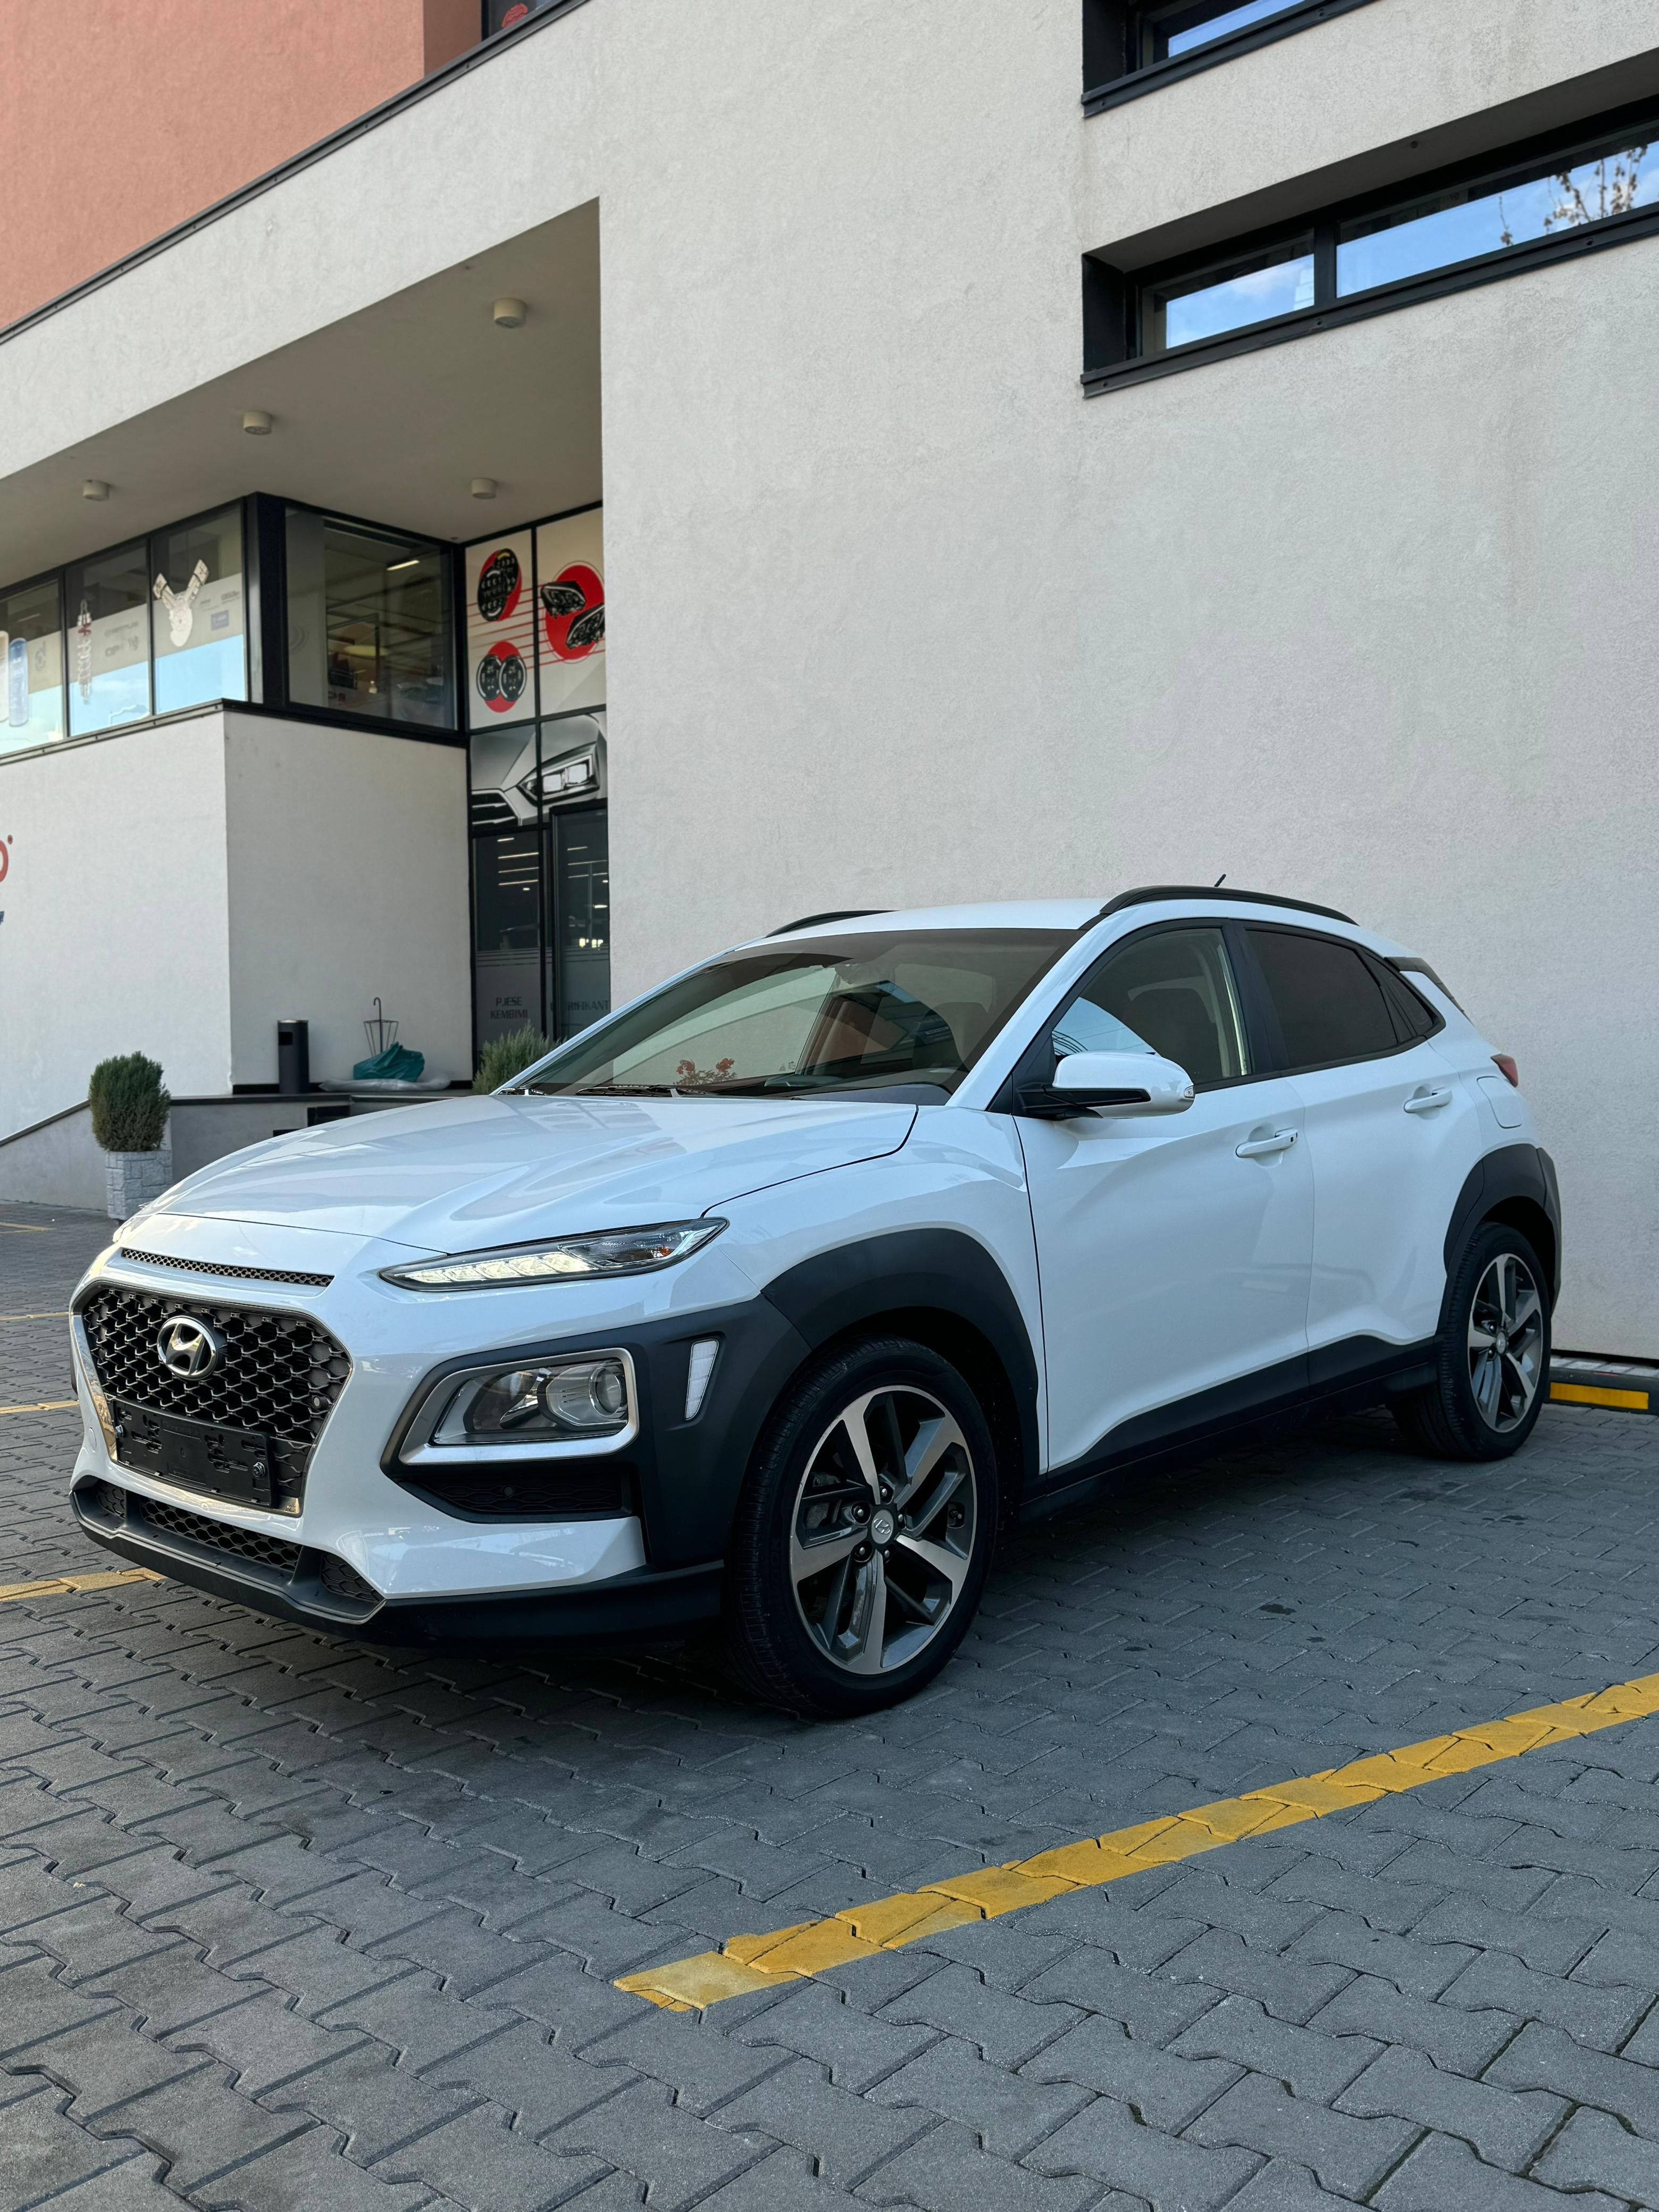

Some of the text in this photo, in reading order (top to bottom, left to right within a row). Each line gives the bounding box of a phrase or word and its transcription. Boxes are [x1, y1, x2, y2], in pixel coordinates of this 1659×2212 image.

[496, 996, 522, 1006] PJESE
[550, 1000, 609, 1011] RIFIKANT
[490, 1009, 527, 1019] KEMBIMI
